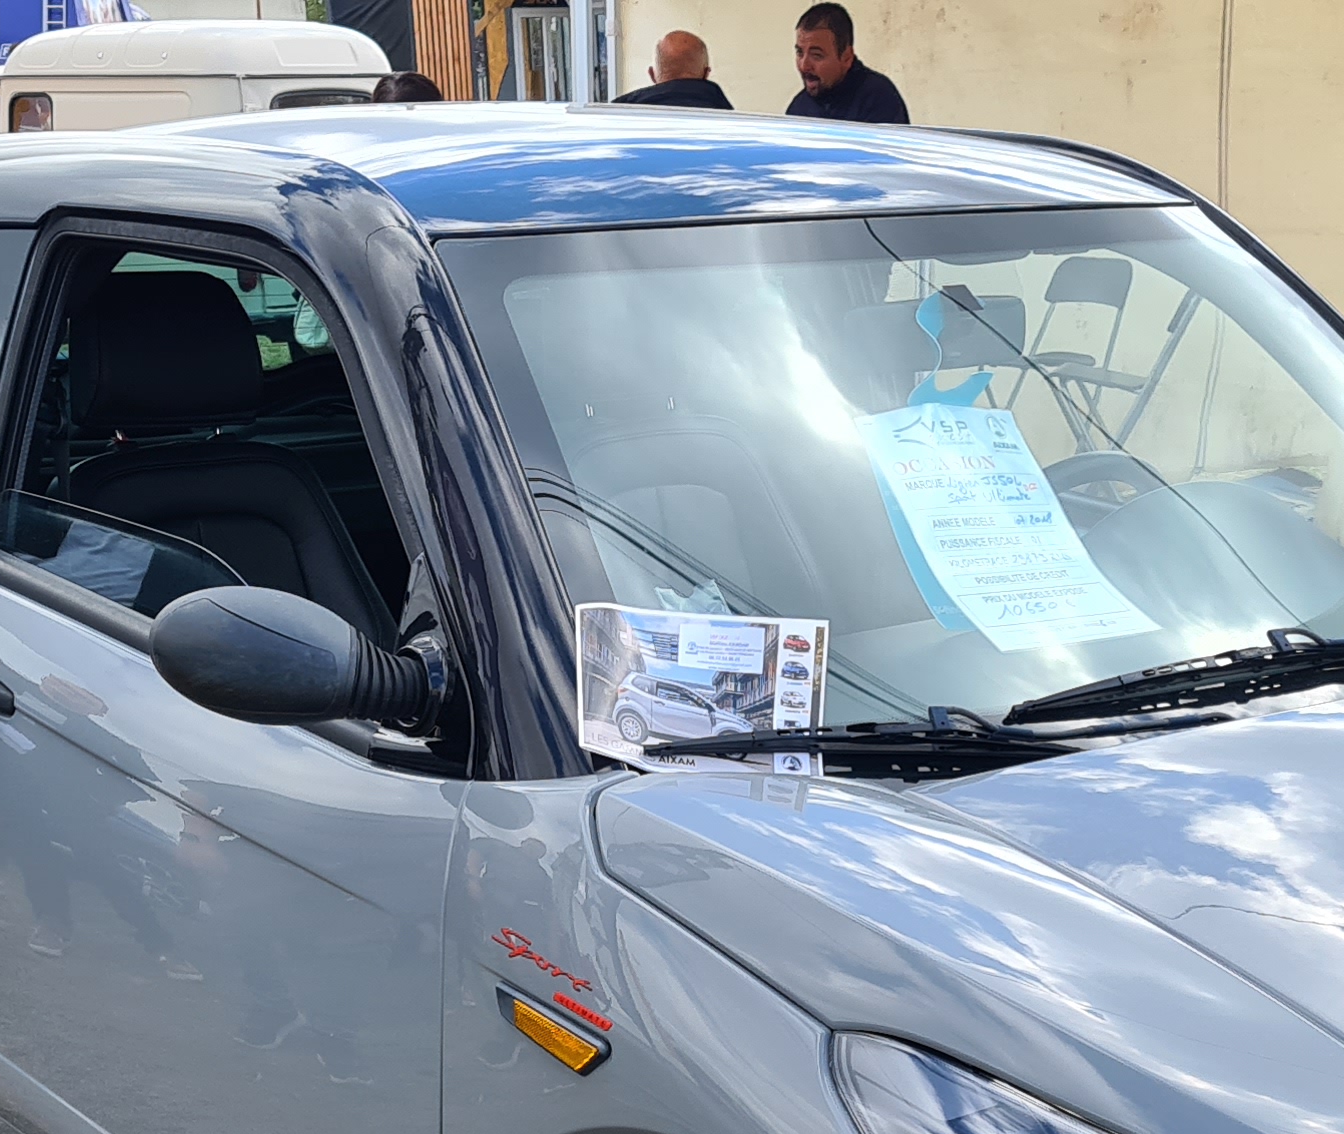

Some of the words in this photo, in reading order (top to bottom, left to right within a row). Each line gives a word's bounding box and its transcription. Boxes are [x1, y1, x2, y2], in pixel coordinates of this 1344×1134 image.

[920, 420, 969, 434] VSP
[892, 455, 996, 476] OCAION
[658, 754, 696, 767] AIXAM
[491, 927, 593, 993] Sport
